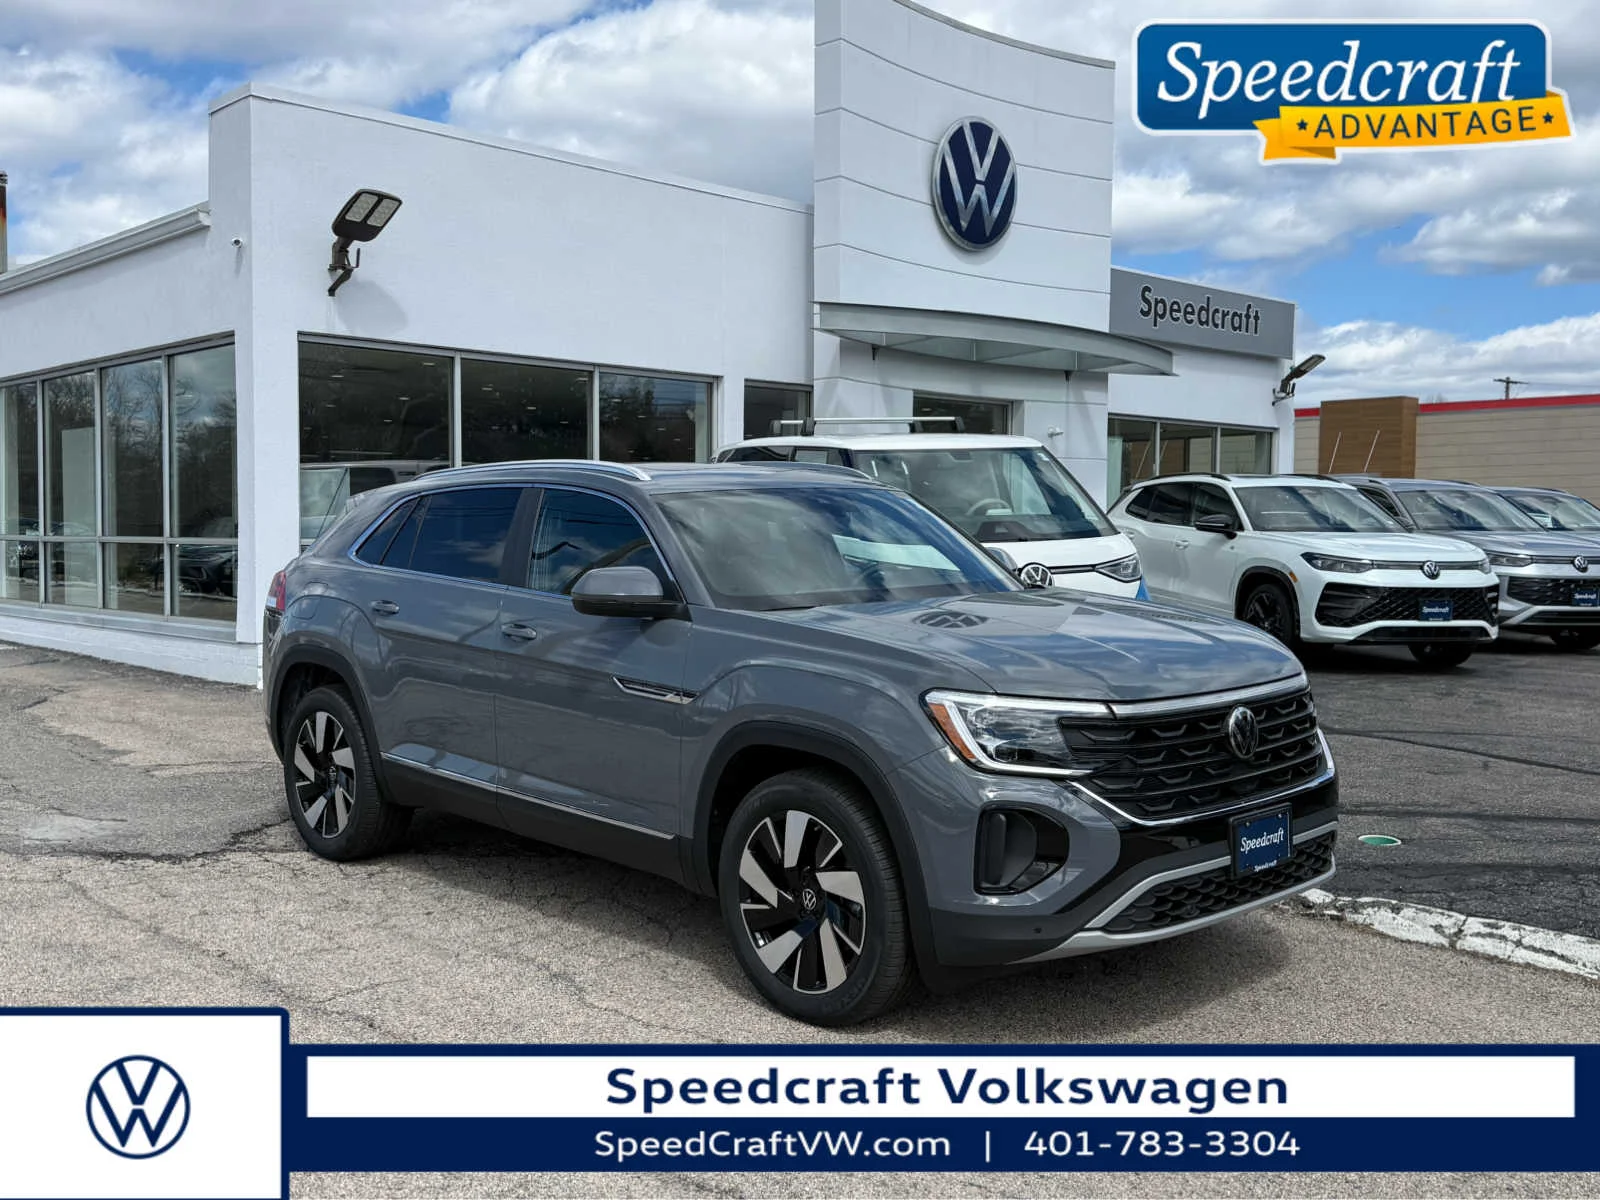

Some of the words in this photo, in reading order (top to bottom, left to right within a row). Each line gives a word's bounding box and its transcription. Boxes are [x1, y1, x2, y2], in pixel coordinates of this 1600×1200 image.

[934, 118, 1017, 249] VW
[1139, 285, 1260, 335] Speedcraft
[1240, 827, 1284, 854] Speedcraft
